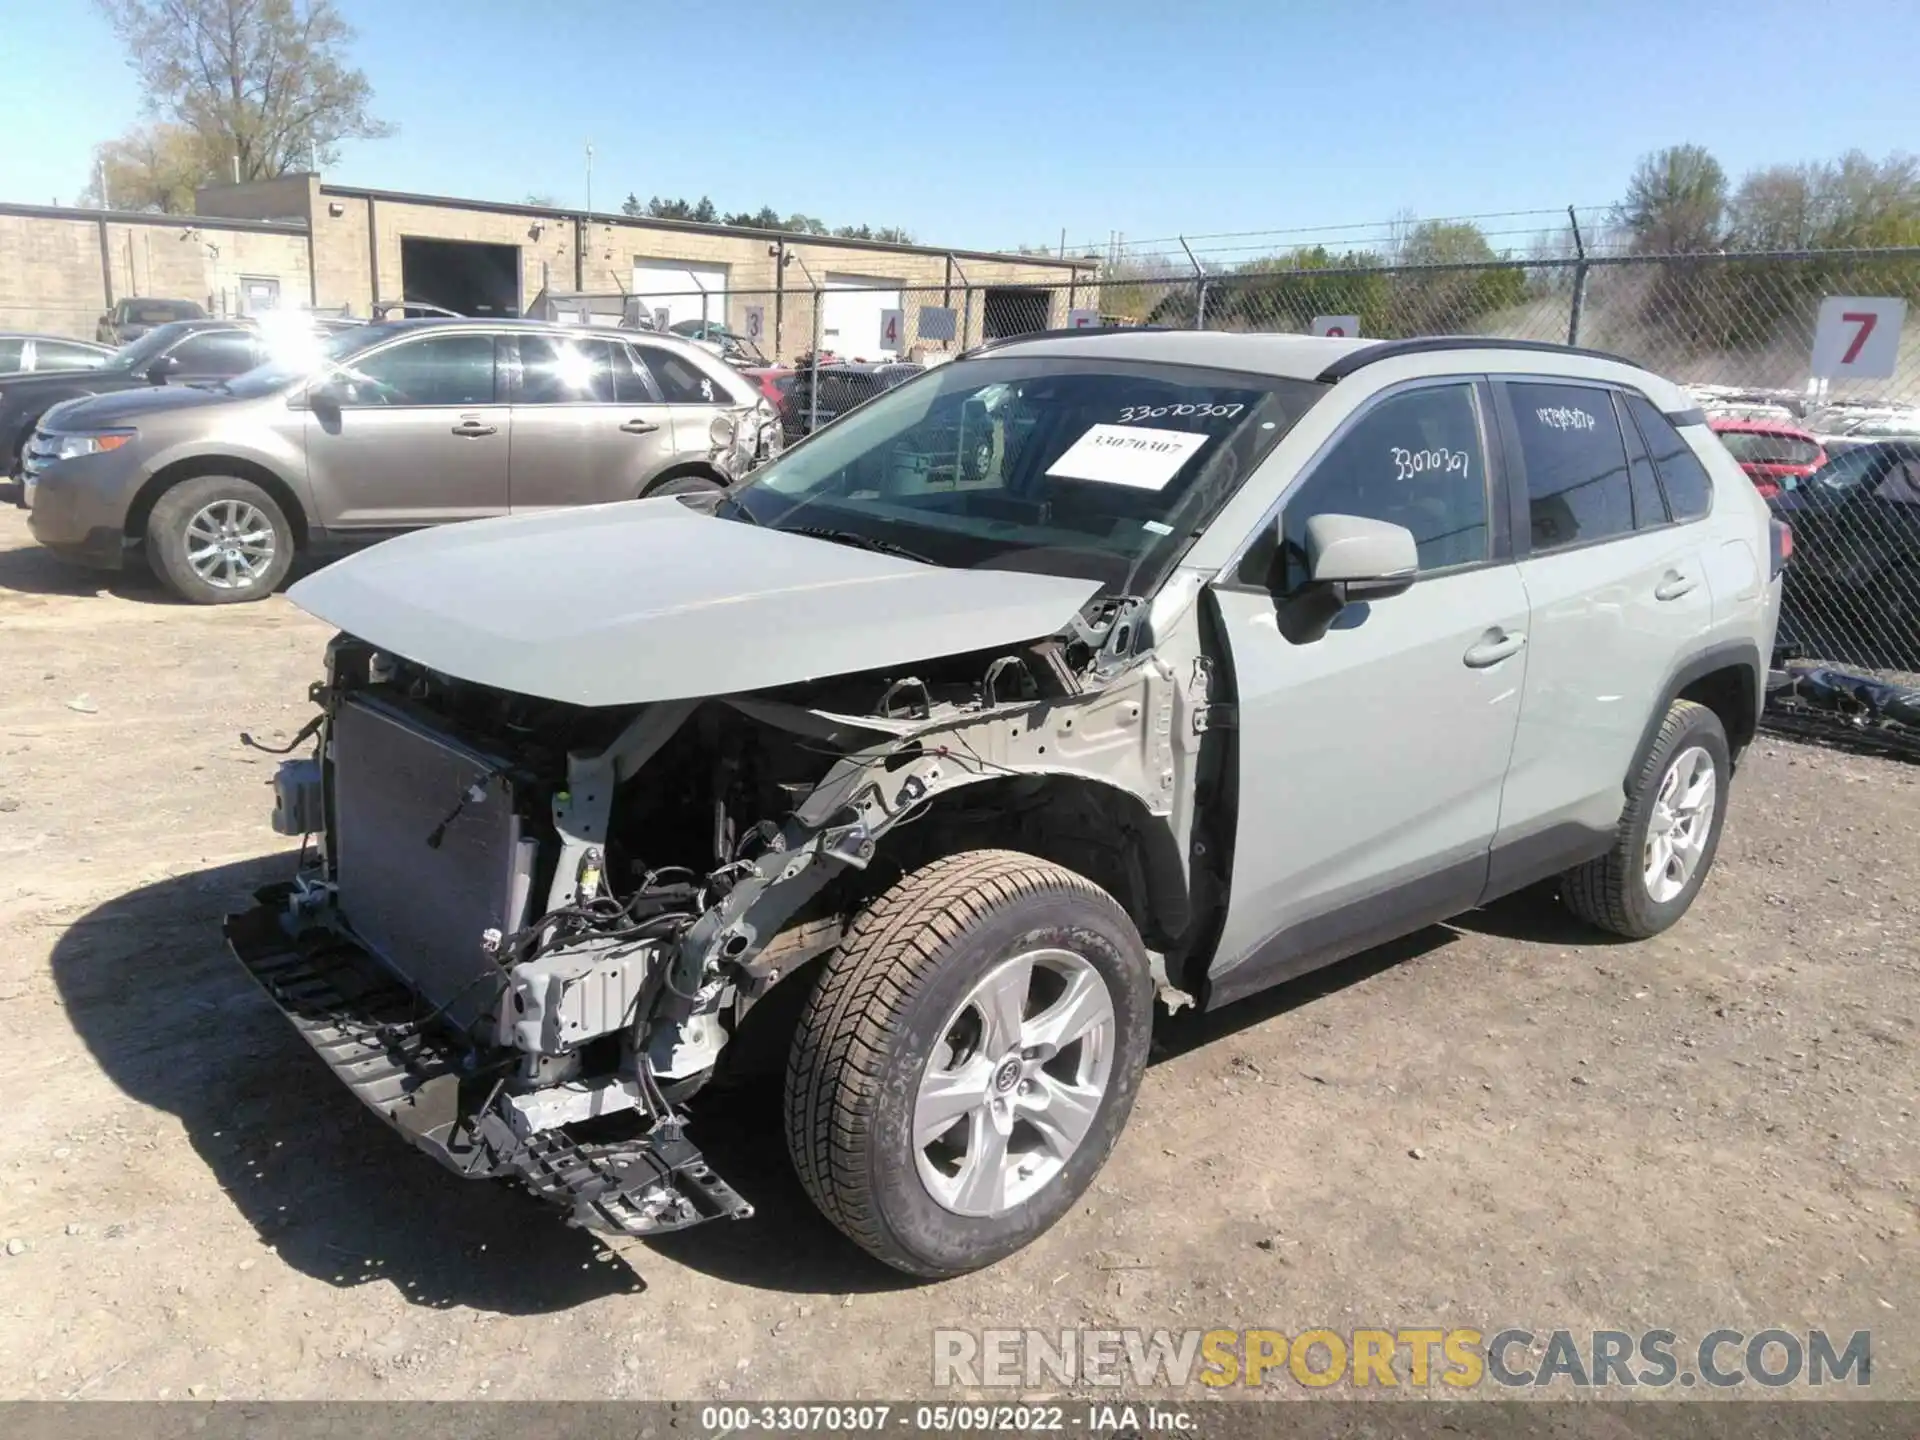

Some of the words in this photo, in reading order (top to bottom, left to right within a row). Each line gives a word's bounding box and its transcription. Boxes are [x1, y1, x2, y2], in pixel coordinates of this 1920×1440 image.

[750, 313, 759, 337] 3
[885, 316, 897, 344] 4
[1841, 312, 1878, 364] 7
[1117, 403, 1245, 424] 33070307
[1390, 447, 1469, 481] 33070307
